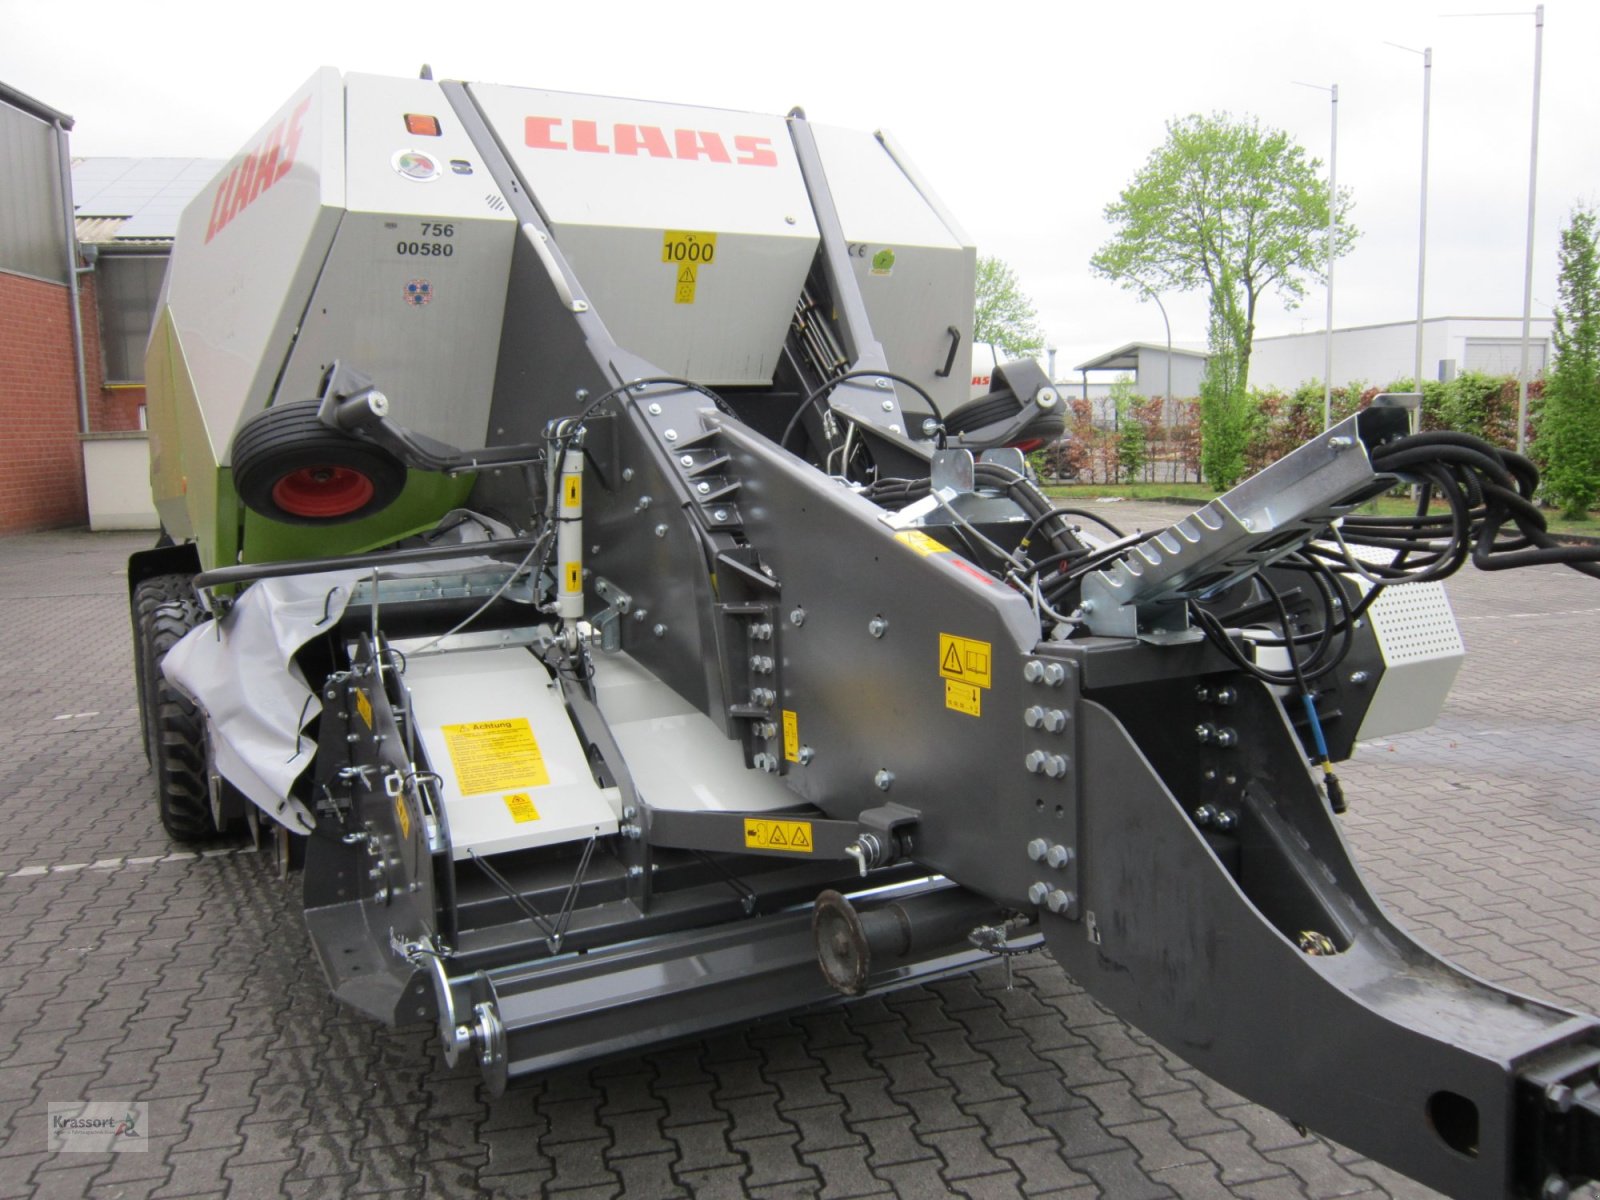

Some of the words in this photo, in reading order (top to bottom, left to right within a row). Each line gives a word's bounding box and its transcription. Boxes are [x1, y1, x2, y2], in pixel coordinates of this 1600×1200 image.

[524, 115, 778, 168] CLAAS
[204, 94, 312, 246] CLAAS
[421, 223, 454, 237] 756
[397, 241, 453, 257] 00580
[665, 242, 714, 262] 1000
[473, 721, 513, 730] Achtung
